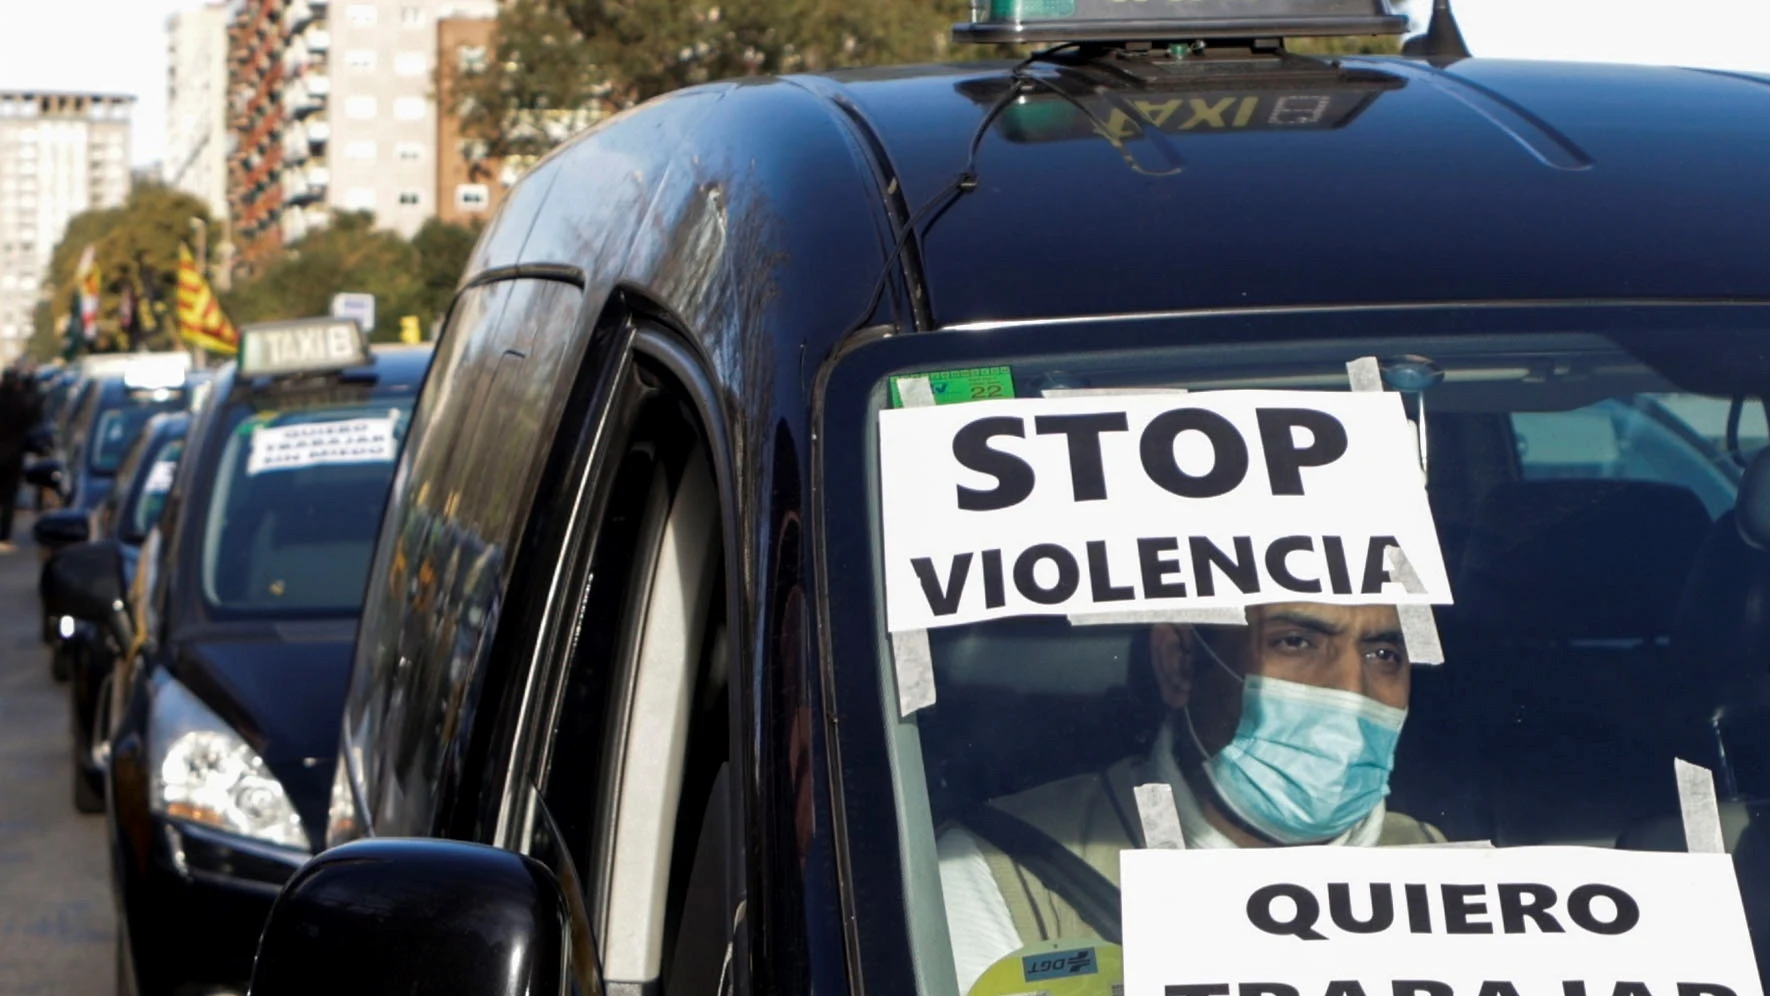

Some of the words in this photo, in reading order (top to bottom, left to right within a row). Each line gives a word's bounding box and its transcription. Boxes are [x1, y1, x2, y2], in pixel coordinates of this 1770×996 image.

[266, 328, 324, 364] TAXI
[327, 325, 354, 358] B
[970, 385, 1003, 399] 22
[953, 409, 1348, 510] STOP
[911, 536, 1428, 615] VIOLENCIA
[1246, 883, 1640, 941] QUIERO
[1028, 959, 1065, 974] DGT
